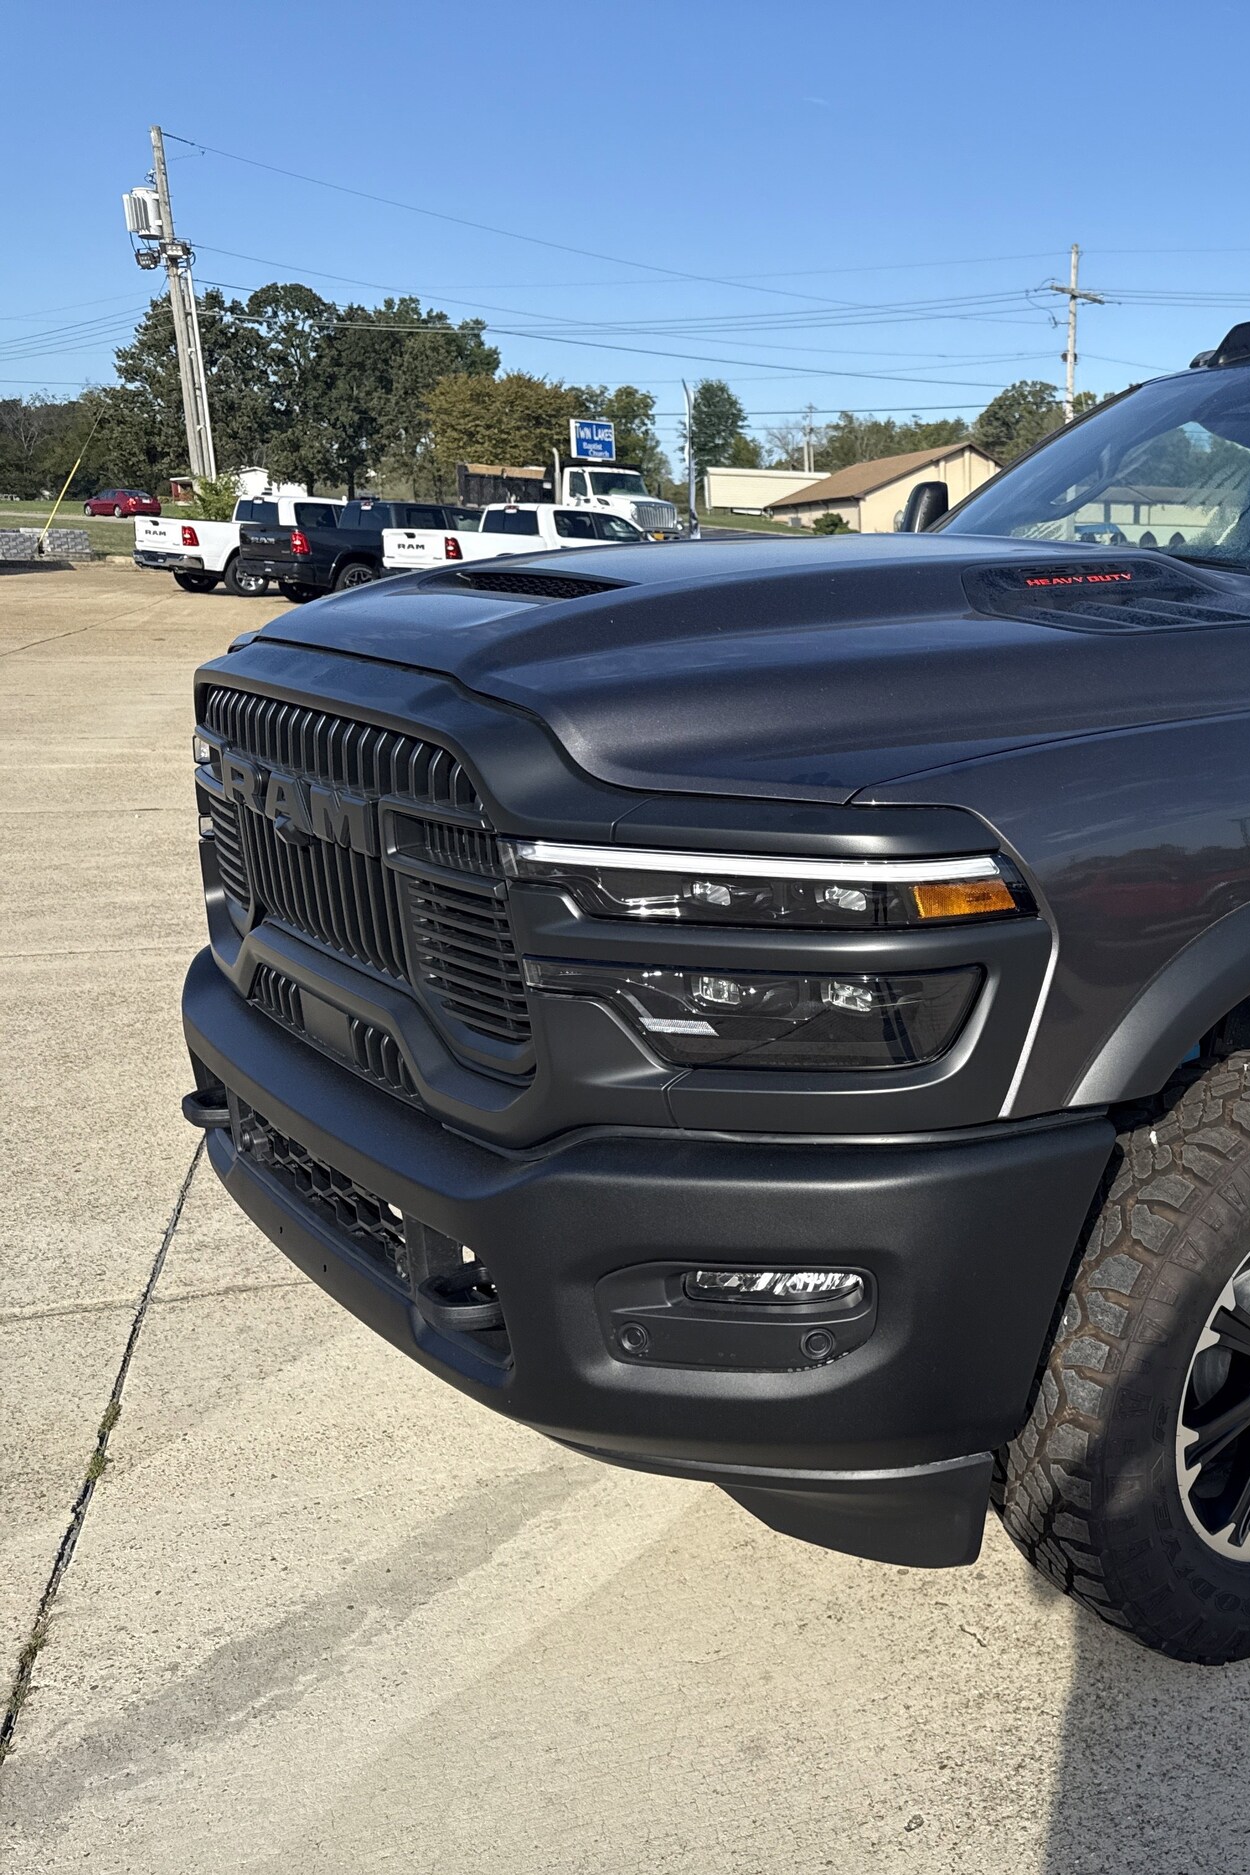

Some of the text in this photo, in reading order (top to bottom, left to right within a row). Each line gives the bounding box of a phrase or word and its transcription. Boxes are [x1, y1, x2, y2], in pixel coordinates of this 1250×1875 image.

[592, 424, 613, 442] LAKES
[144, 529, 167, 537] RAM
[251, 536, 275, 545] RAM
[397, 543, 425, 551] RAM
[1026, 572, 1132, 586] HEAVY DUTY
[222, 750, 381, 858] RAM
